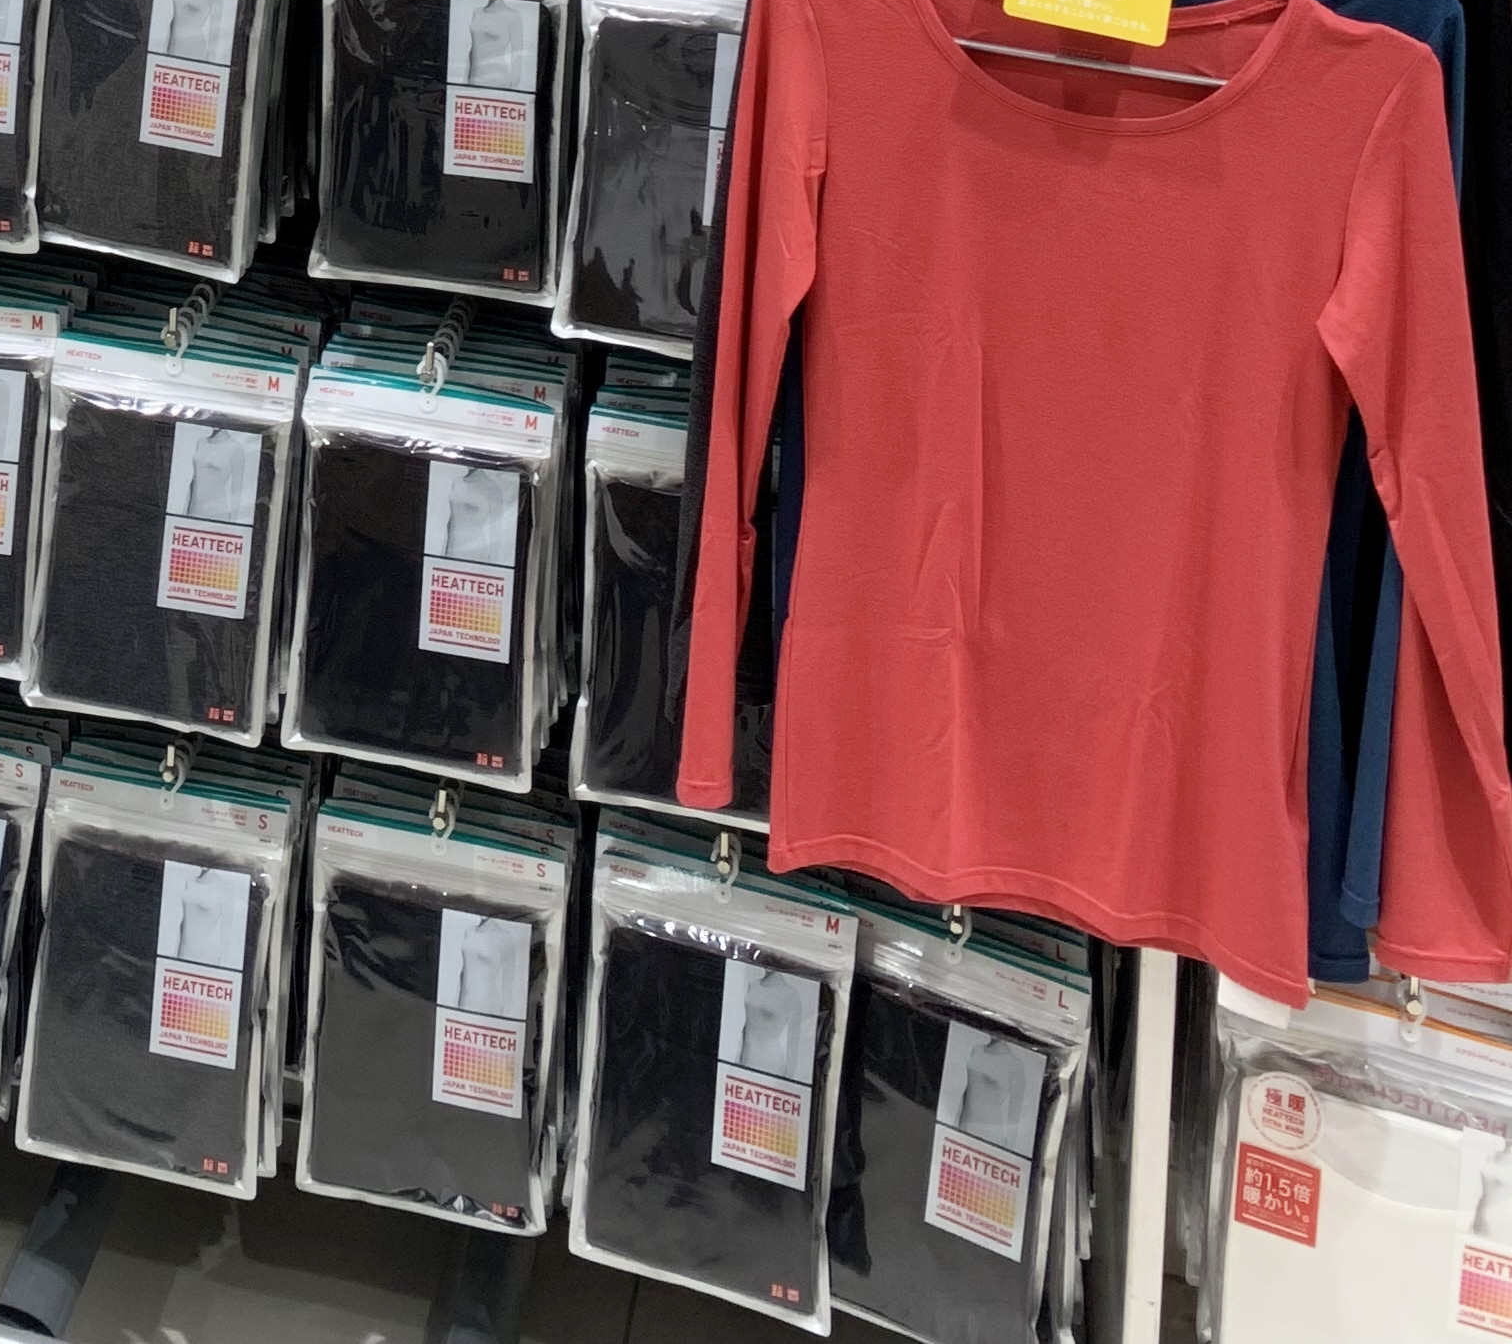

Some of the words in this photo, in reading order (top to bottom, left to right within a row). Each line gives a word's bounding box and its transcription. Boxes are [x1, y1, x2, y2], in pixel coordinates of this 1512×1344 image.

[154, 71, 220, 94] HEATTECH
[454, 101, 526, 122] HEATTECH
[32, 315, 43, 330] M
[268, 376, 279, 391] M
[525, 416, 538, 430] M
[172, 533, 243, 554] HEATTECH
[432, 574, 504, 597] HEATTECH
[430, 627, 453, 637] JAPAN
[456, 630, 501, 646] TECHNOLOGY
[258, 814, 267, 829] S
[825, 915, 840, 934] M
[163, 975, 232, 1001] HEATTECH
[1058, 990, 1068, 1008] L
[444, 1025, 516, 1052] HEATTECH
[725, 1083, 801, 1117] HEATTECH
[942, 1144, 1020, 1187] HEATTECH
[1244, 1166, 1313, 1205] 約1.5倍
[1243, 1184, 1310, 1223] 暖かい。
